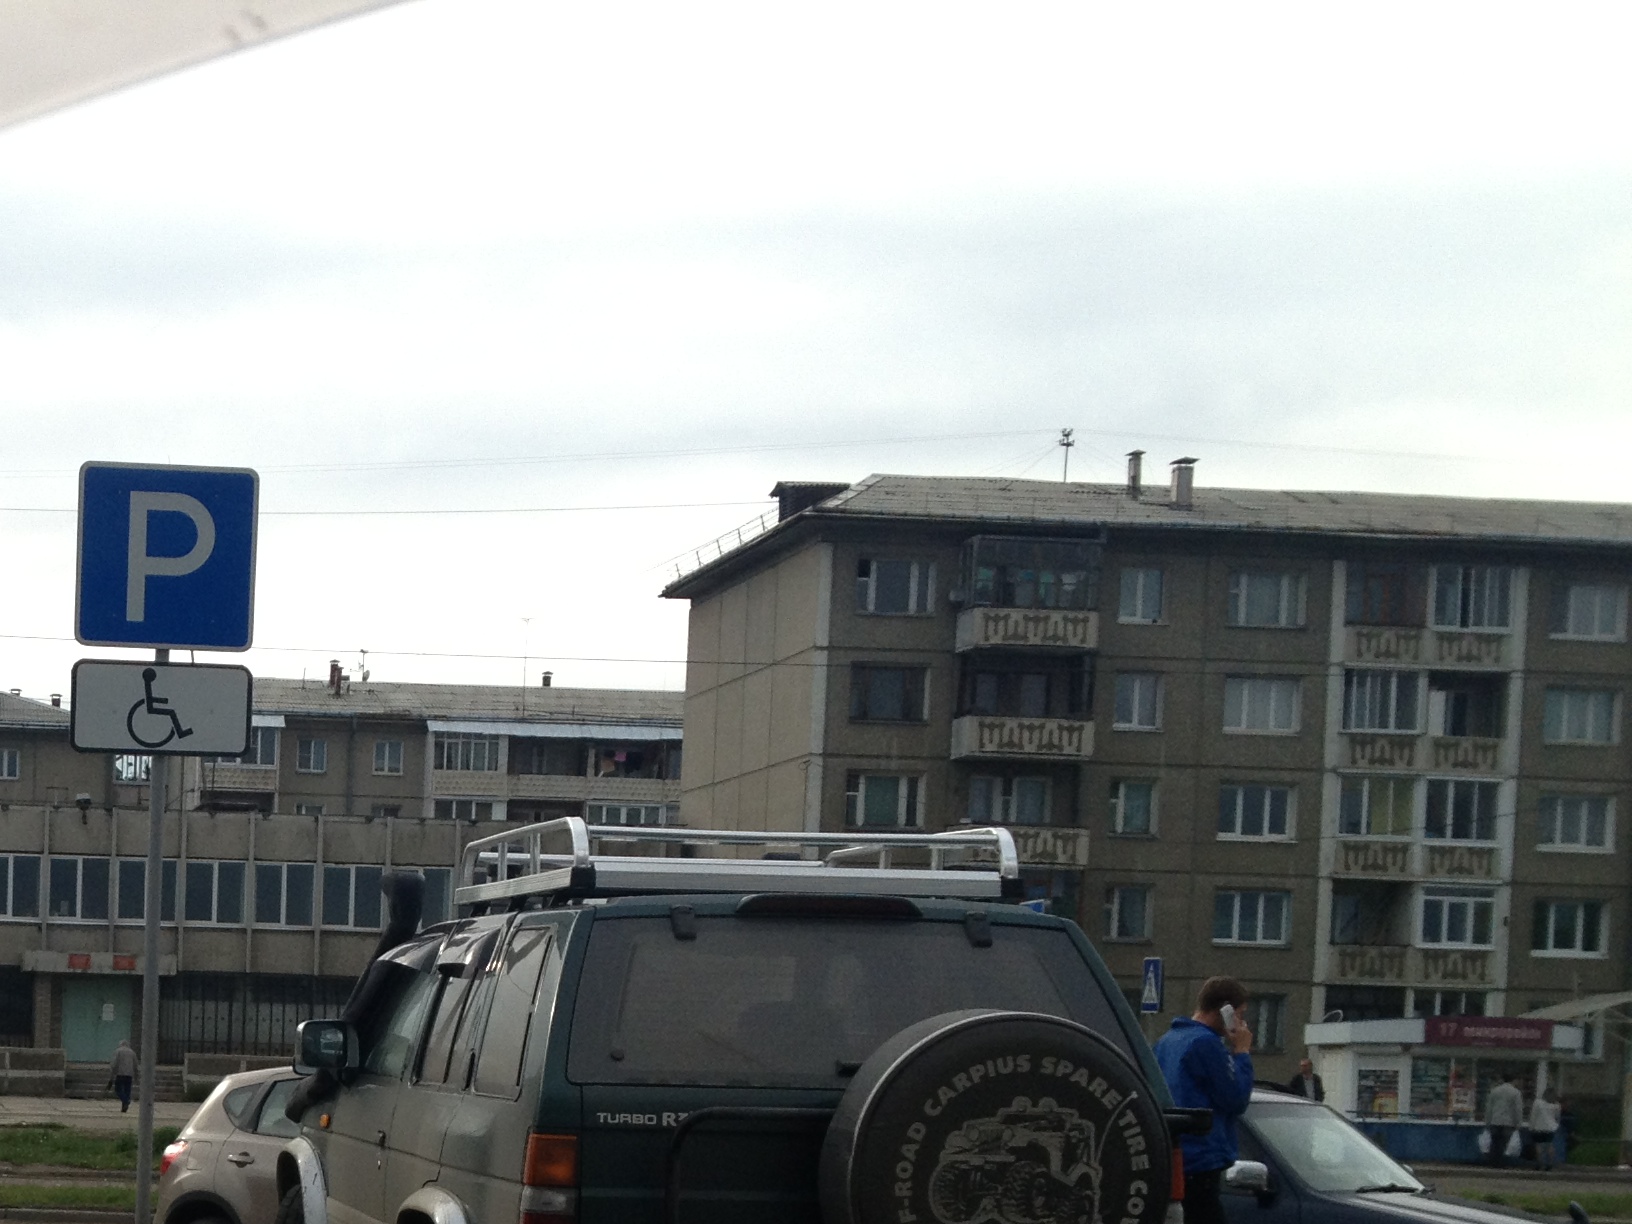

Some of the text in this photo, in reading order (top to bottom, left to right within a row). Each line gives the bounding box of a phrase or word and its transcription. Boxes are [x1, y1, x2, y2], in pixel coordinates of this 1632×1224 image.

[126, 490, 216, 622] P
[596, 1112, 657, 1125] TURBO
[923, 1054, 1032, 1117] CARPIUS
[1040, 1056, 1123, 1110] SPARE
[1118, 1109, 1150, 1171] TIRE
